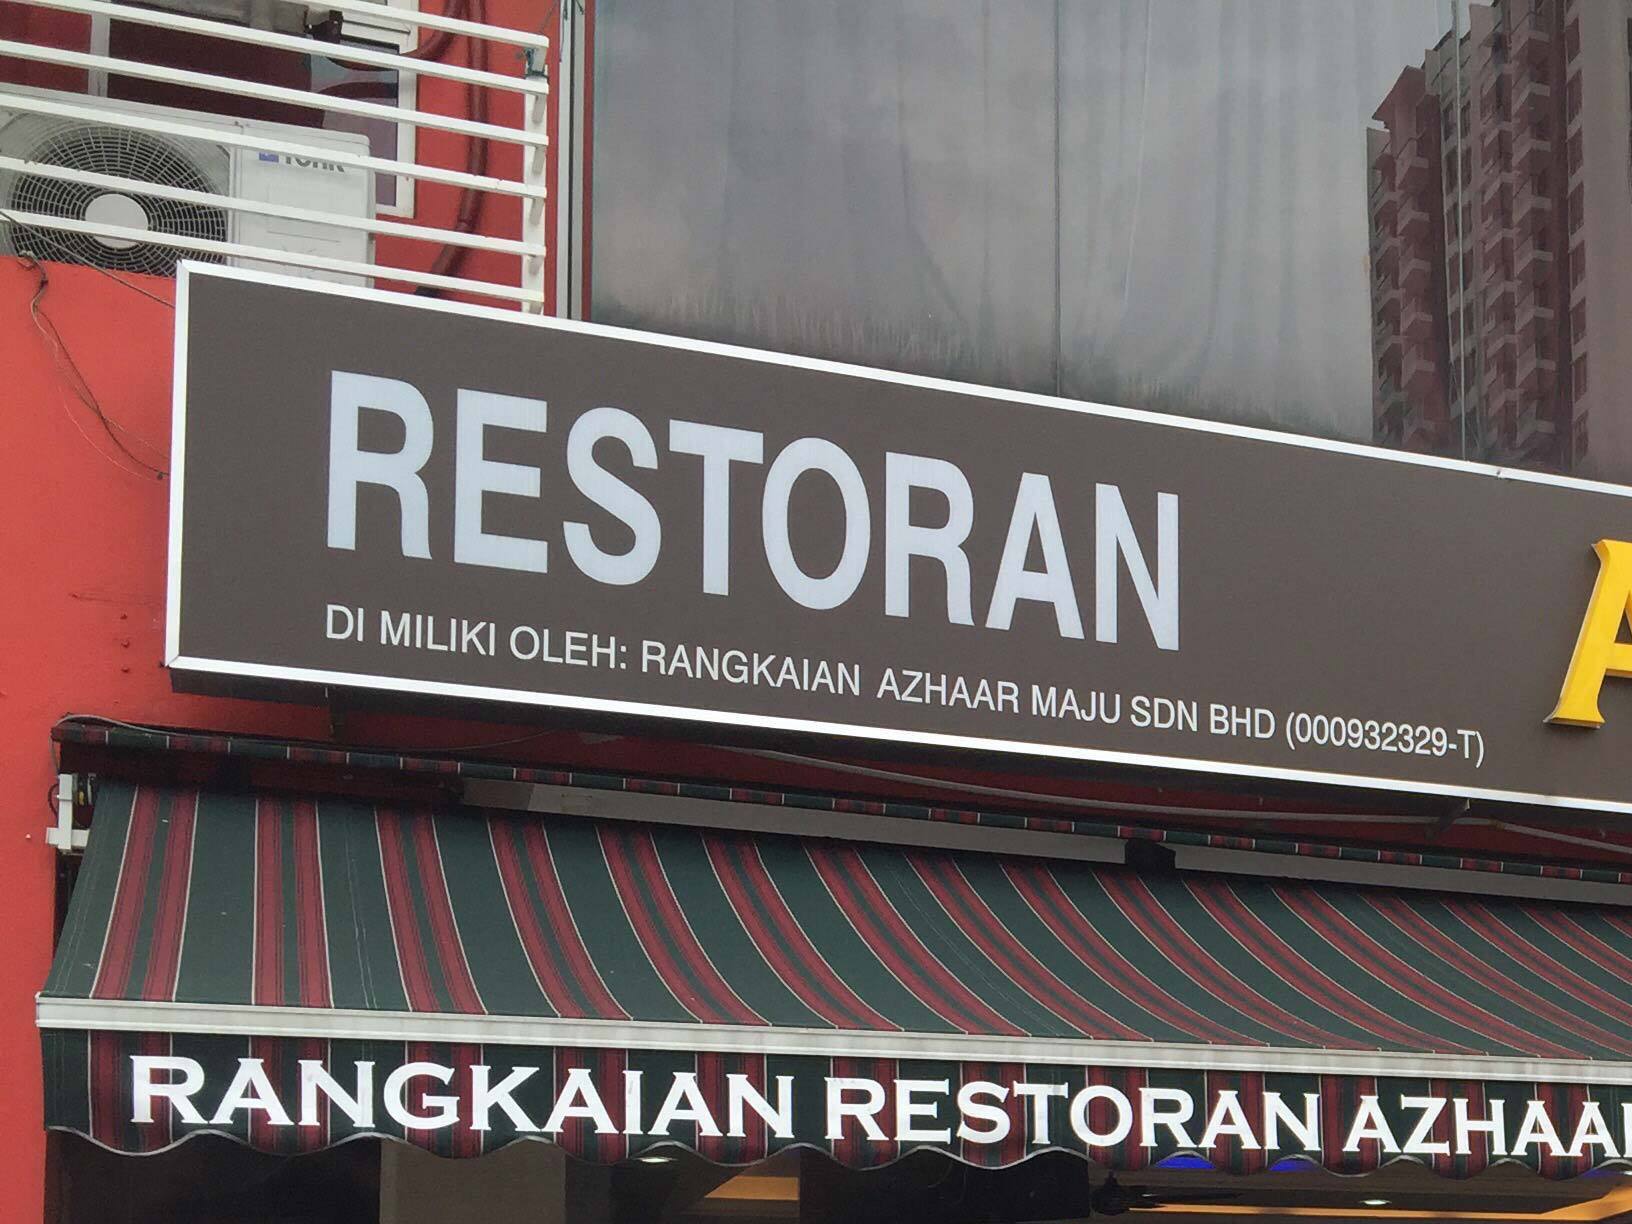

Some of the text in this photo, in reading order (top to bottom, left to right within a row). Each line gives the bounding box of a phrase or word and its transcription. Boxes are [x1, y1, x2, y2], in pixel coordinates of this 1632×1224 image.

[326, 370, 1180, 651] RESTORAN
[325, 604, 1485, 768] DI MILIKI OLEH: RANGKAIAN AZHAAR MAJU SDN BHD (000932329-T)
[129, 1055, 797, 1140] RANGKAIAN
[824, 1076, 1324, 1153] RESTORAN
